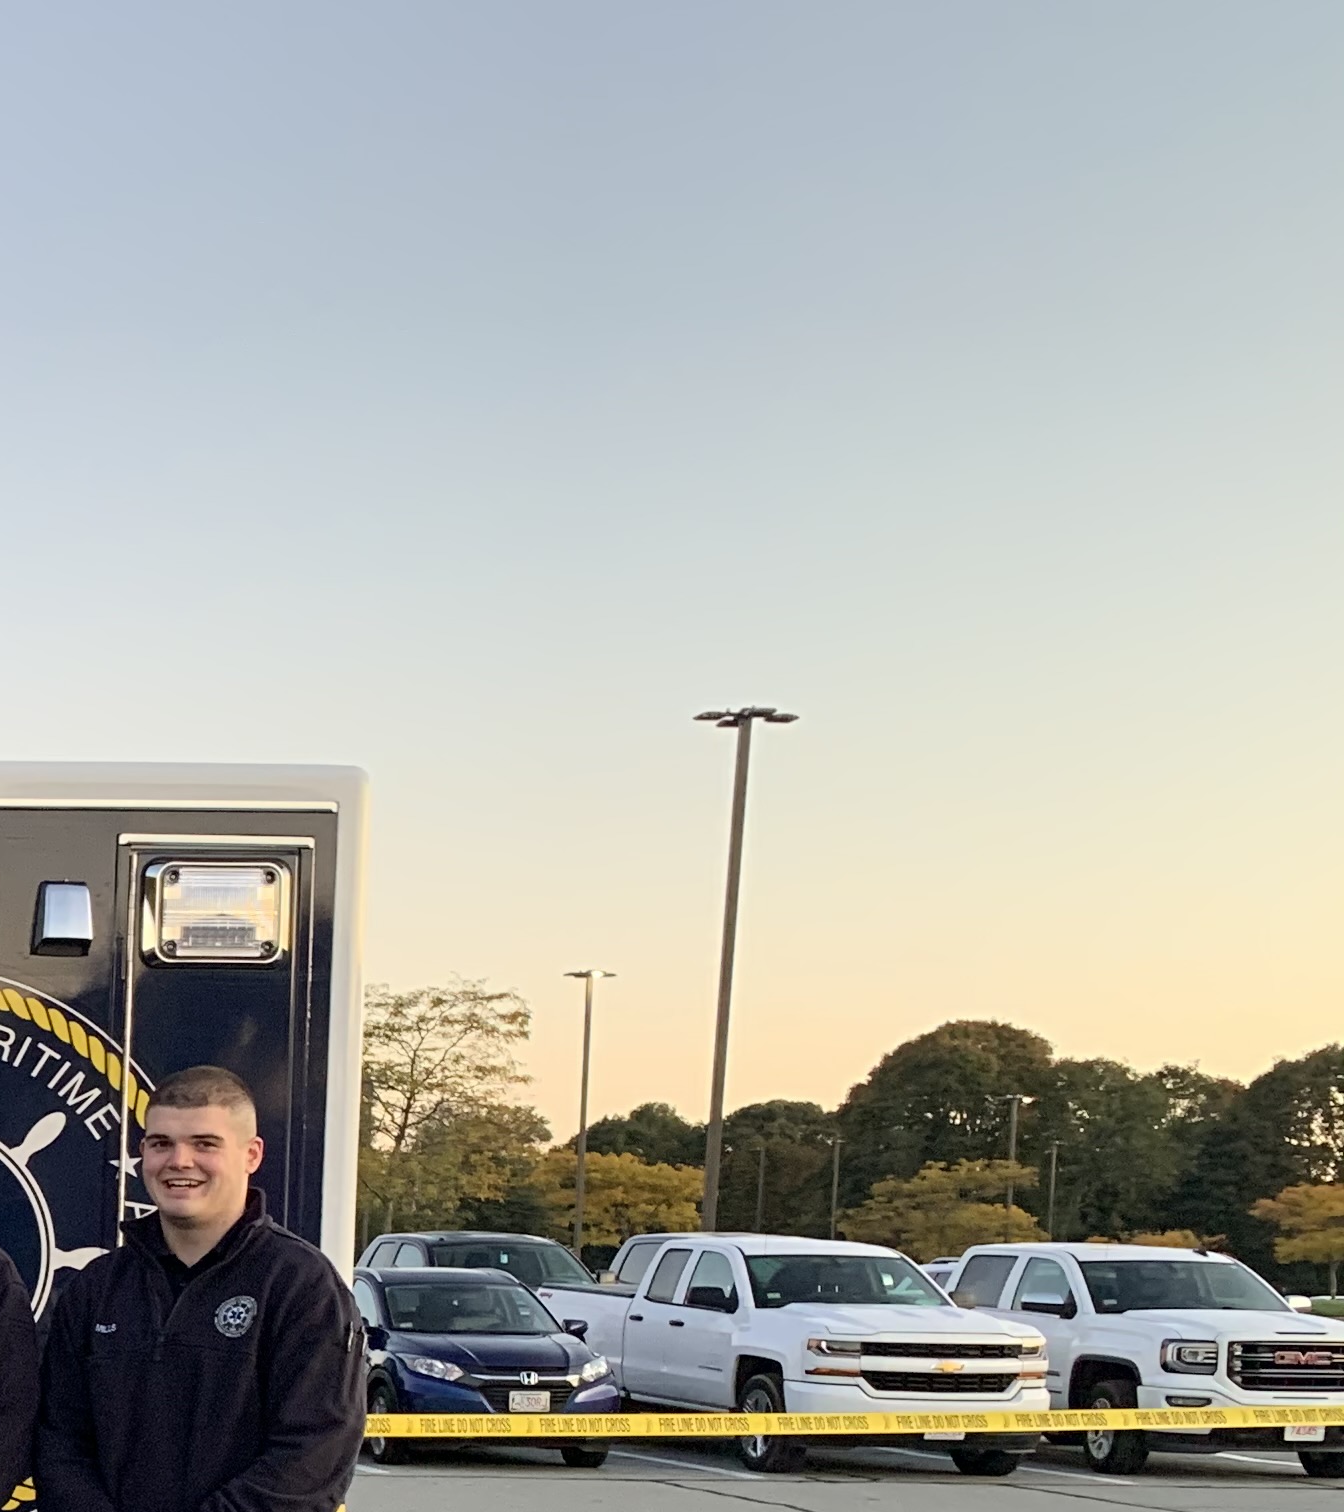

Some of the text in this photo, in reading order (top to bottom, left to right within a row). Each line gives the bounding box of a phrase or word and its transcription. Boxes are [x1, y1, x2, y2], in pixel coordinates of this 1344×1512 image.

[1275, 1351, 1333, 1366] GMC
[419, 1418, 511, 1433] FIRE LINE DO NOT CROSS
[539, 1418, 631, 1433] FIRE LINE DO NOT CROSS
[658, 1416, 750, 1432] FIRE LINE DO NOT CROSS
[777, 1416, 869, 1431] FIRE LINE DO NOT CROSS
[896, 1415, 988, 1429] FIRE LINE DO NOT CROSS
[1015, 1413, 1108, 1427] FIRE LINE DO NOT CROSS
